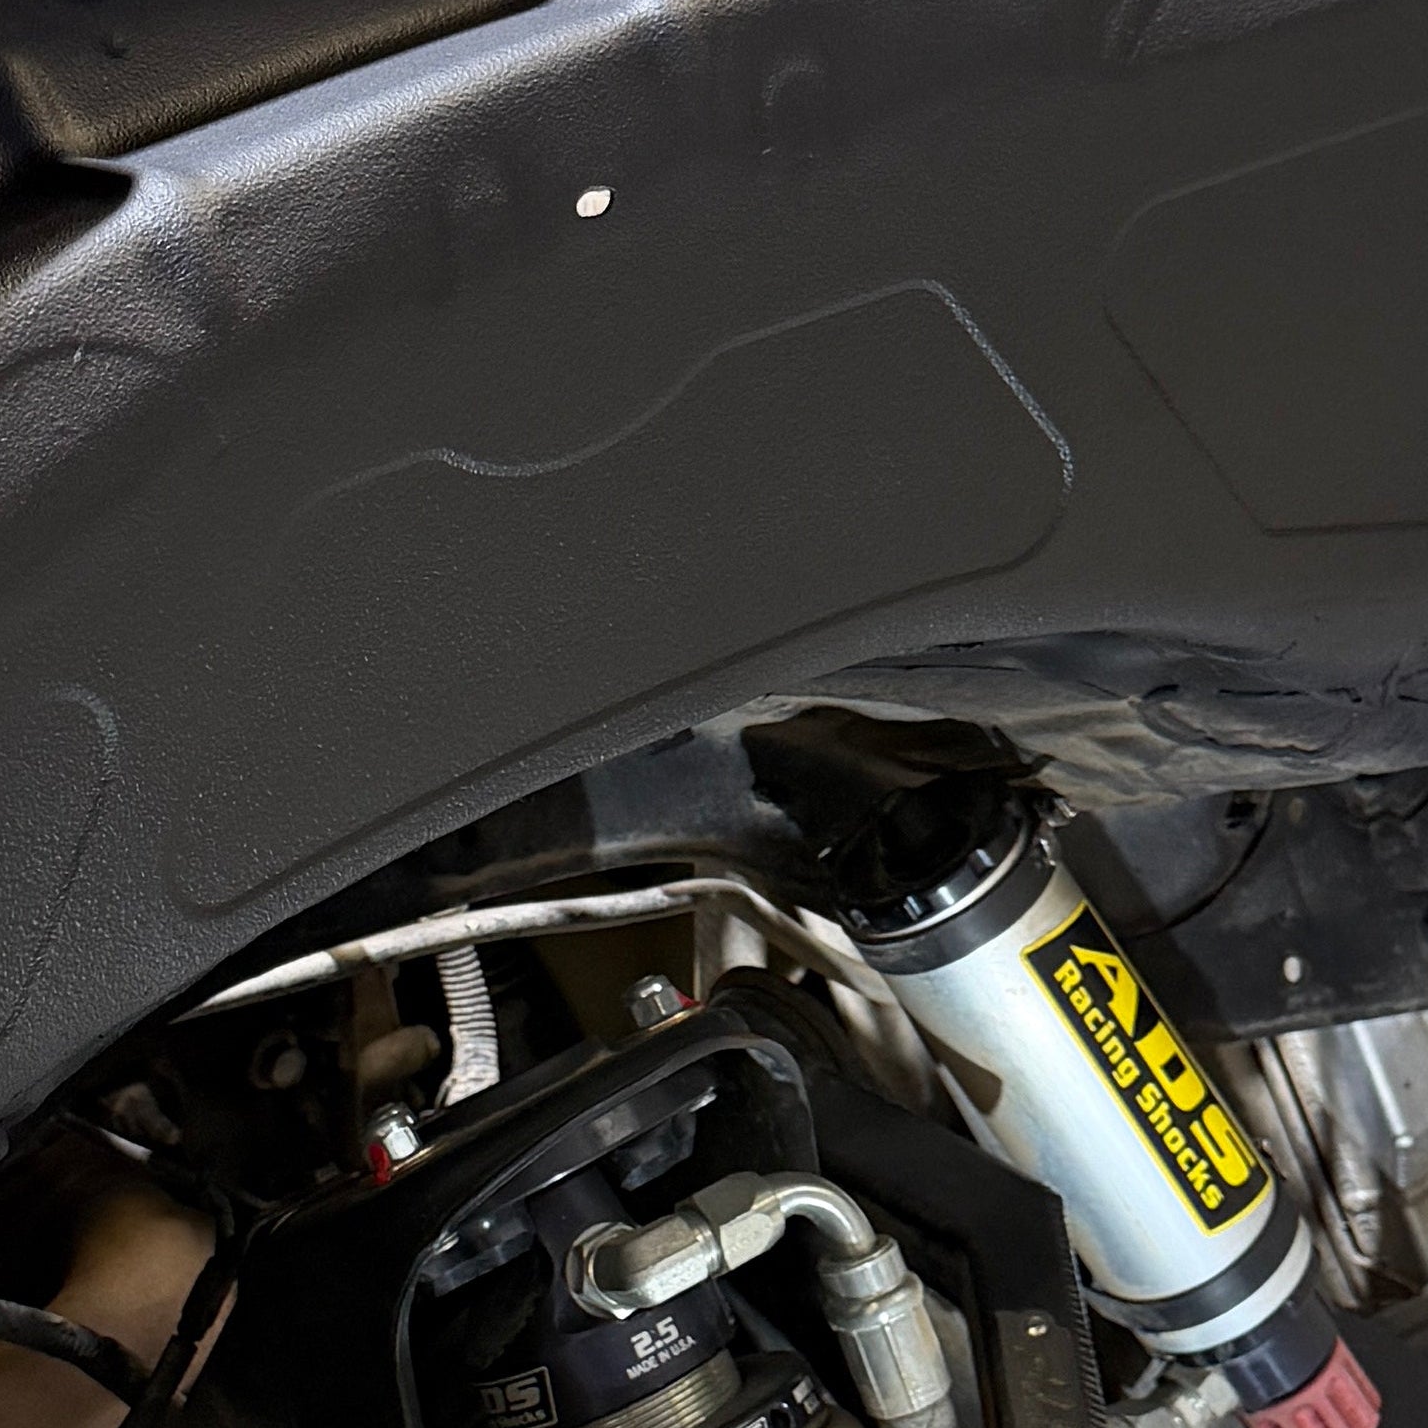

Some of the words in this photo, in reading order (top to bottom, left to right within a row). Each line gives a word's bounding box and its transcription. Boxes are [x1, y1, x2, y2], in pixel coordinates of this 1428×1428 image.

[1053, 958, 1141, 1089] Racing
[1134, 1081, 1225, 1210] Shocks
[1069, 944, 1257, 1188] ADS
[630, 1316, 680, 1360] 2.5
[625, 1354, 660, 1381] MADE
[657, 1346, 672, 1365] IN
[477, 1375, 541, 1415] DS
